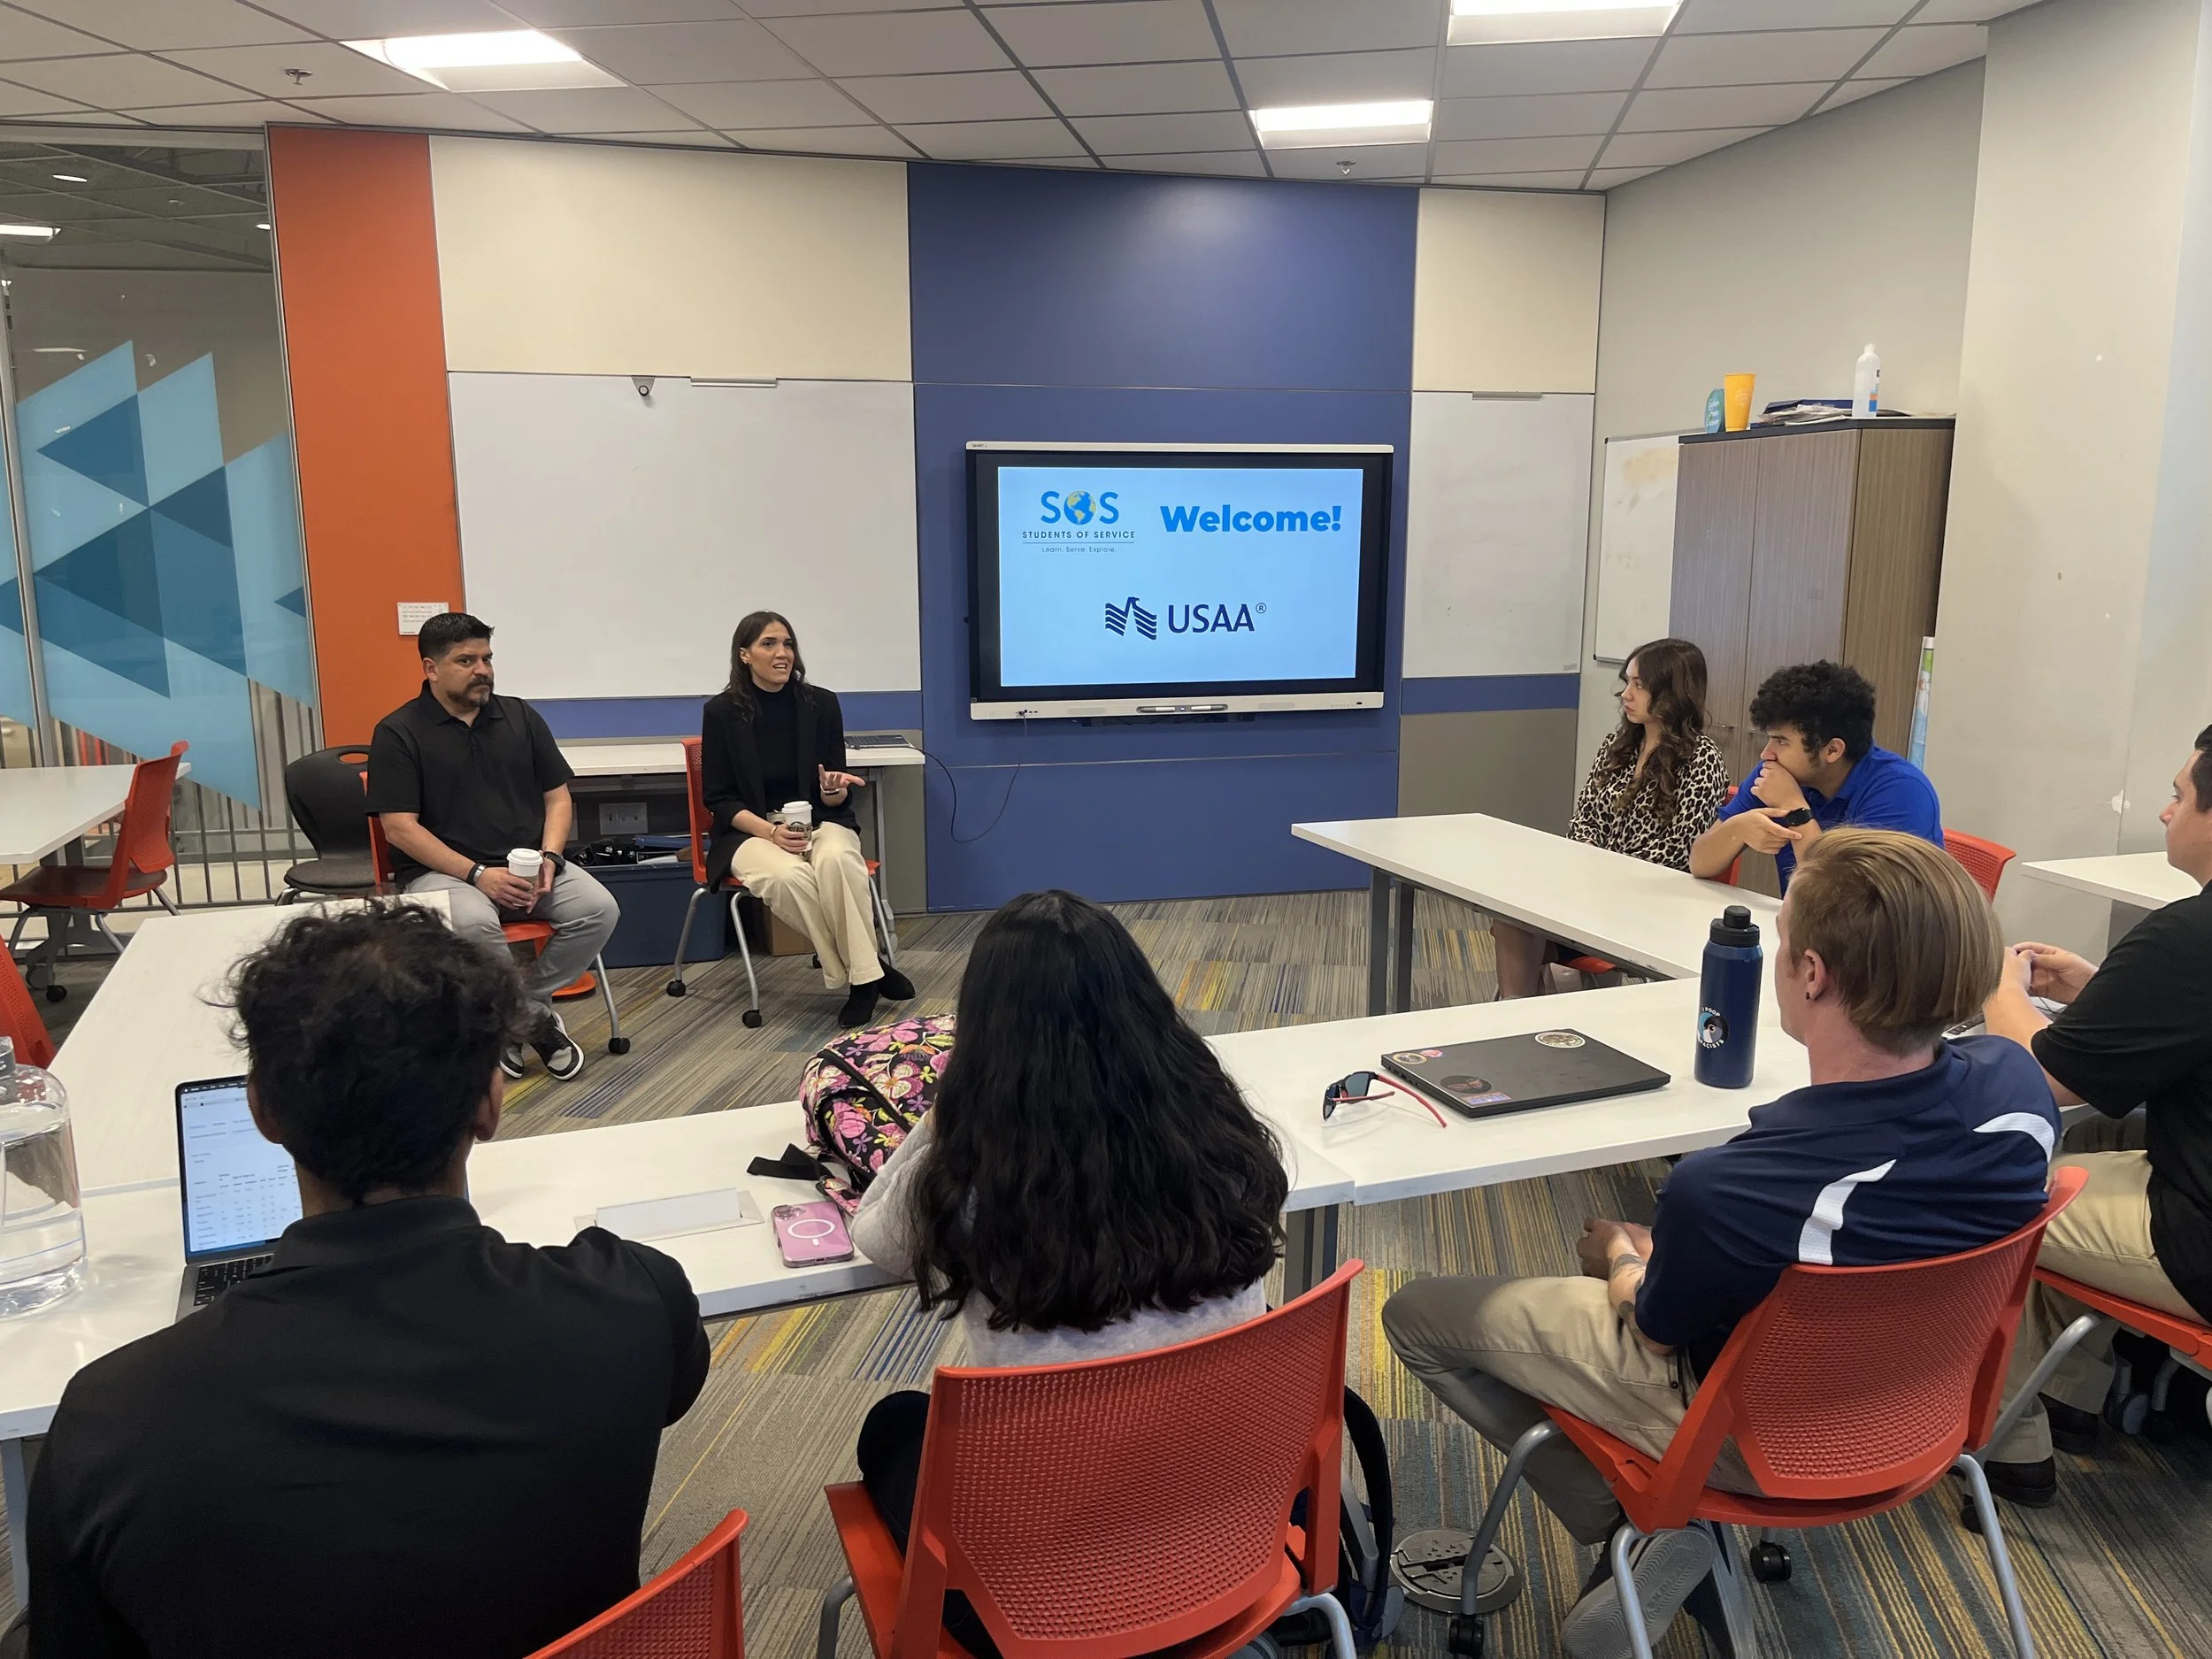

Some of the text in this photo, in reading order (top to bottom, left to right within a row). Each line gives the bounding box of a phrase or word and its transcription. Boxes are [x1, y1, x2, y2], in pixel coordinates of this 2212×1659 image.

[1041, 490, 1119, 526] SOS
[1159, 504, 1342, 532] Welcome!
[1088, 546, 1117, 555] Explore.
[1705, 1007, 1721, 1017] POOP
